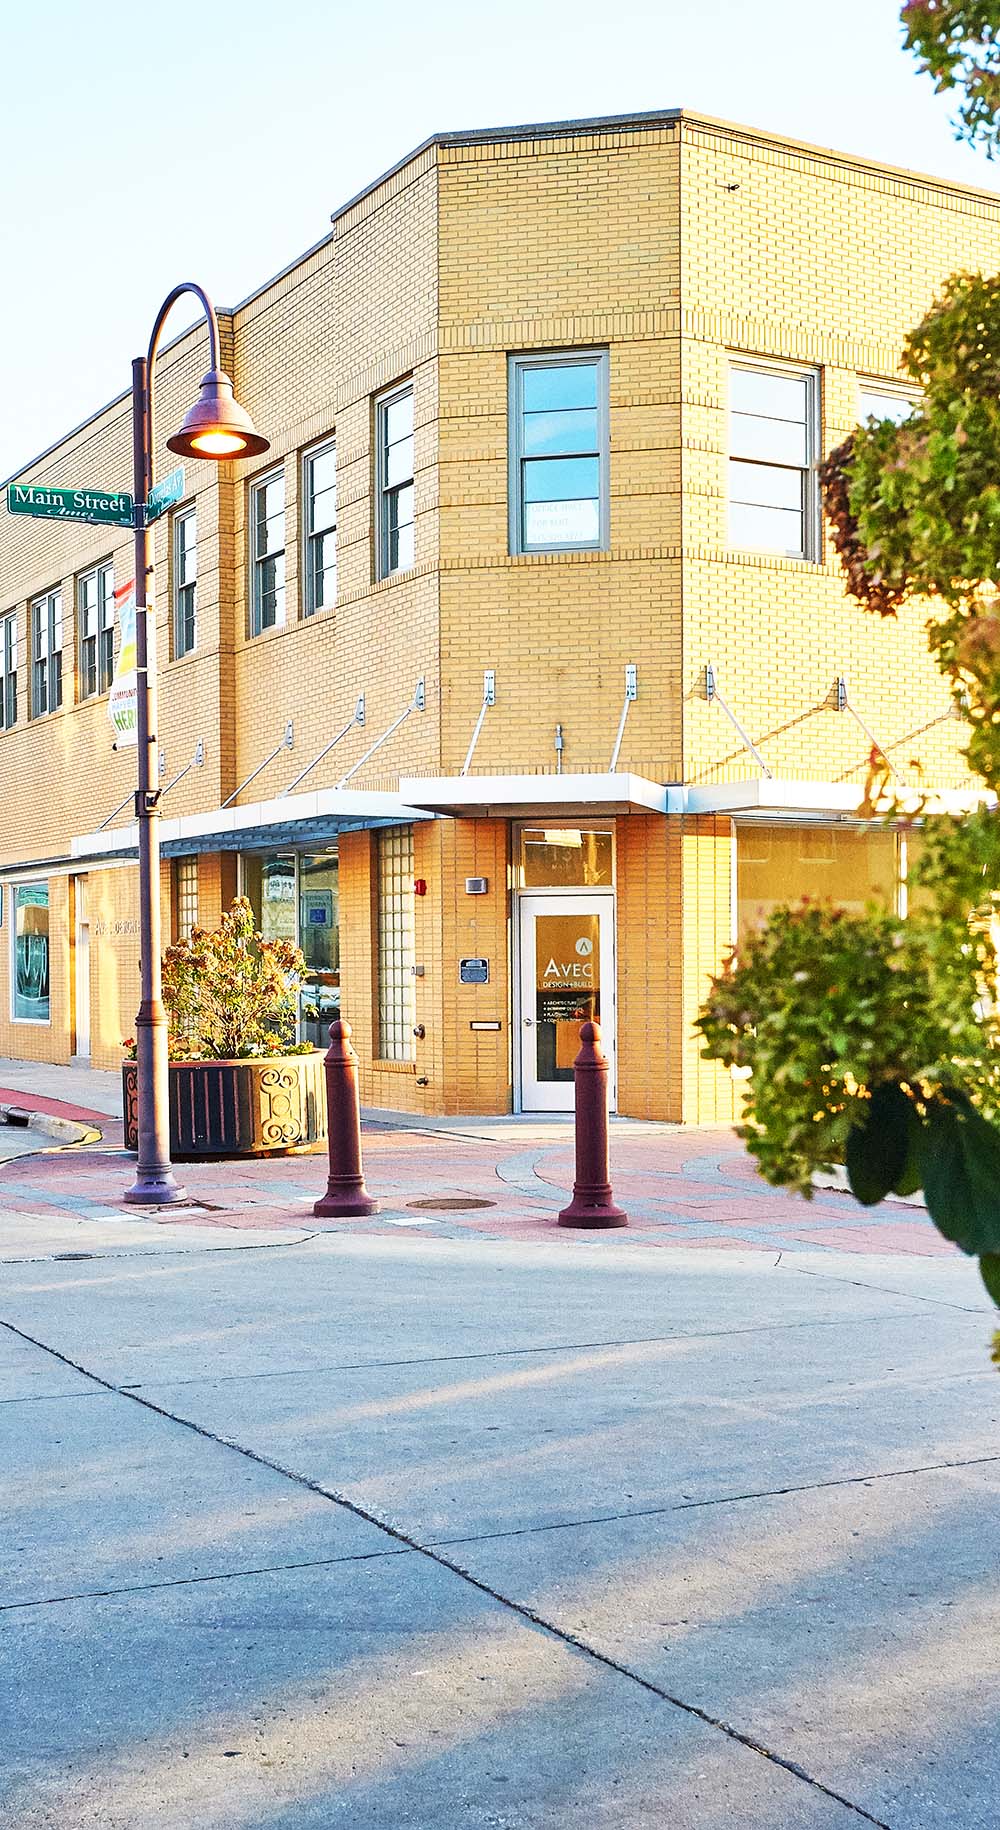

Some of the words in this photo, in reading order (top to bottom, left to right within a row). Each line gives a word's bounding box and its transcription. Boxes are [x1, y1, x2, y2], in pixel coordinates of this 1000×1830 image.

[15, 486, 64, 506] Main
[73, 492, 126, 512] Street
[112, 688, 137, 701] COMMUNIT
[113, 708, 137, 731] HER
